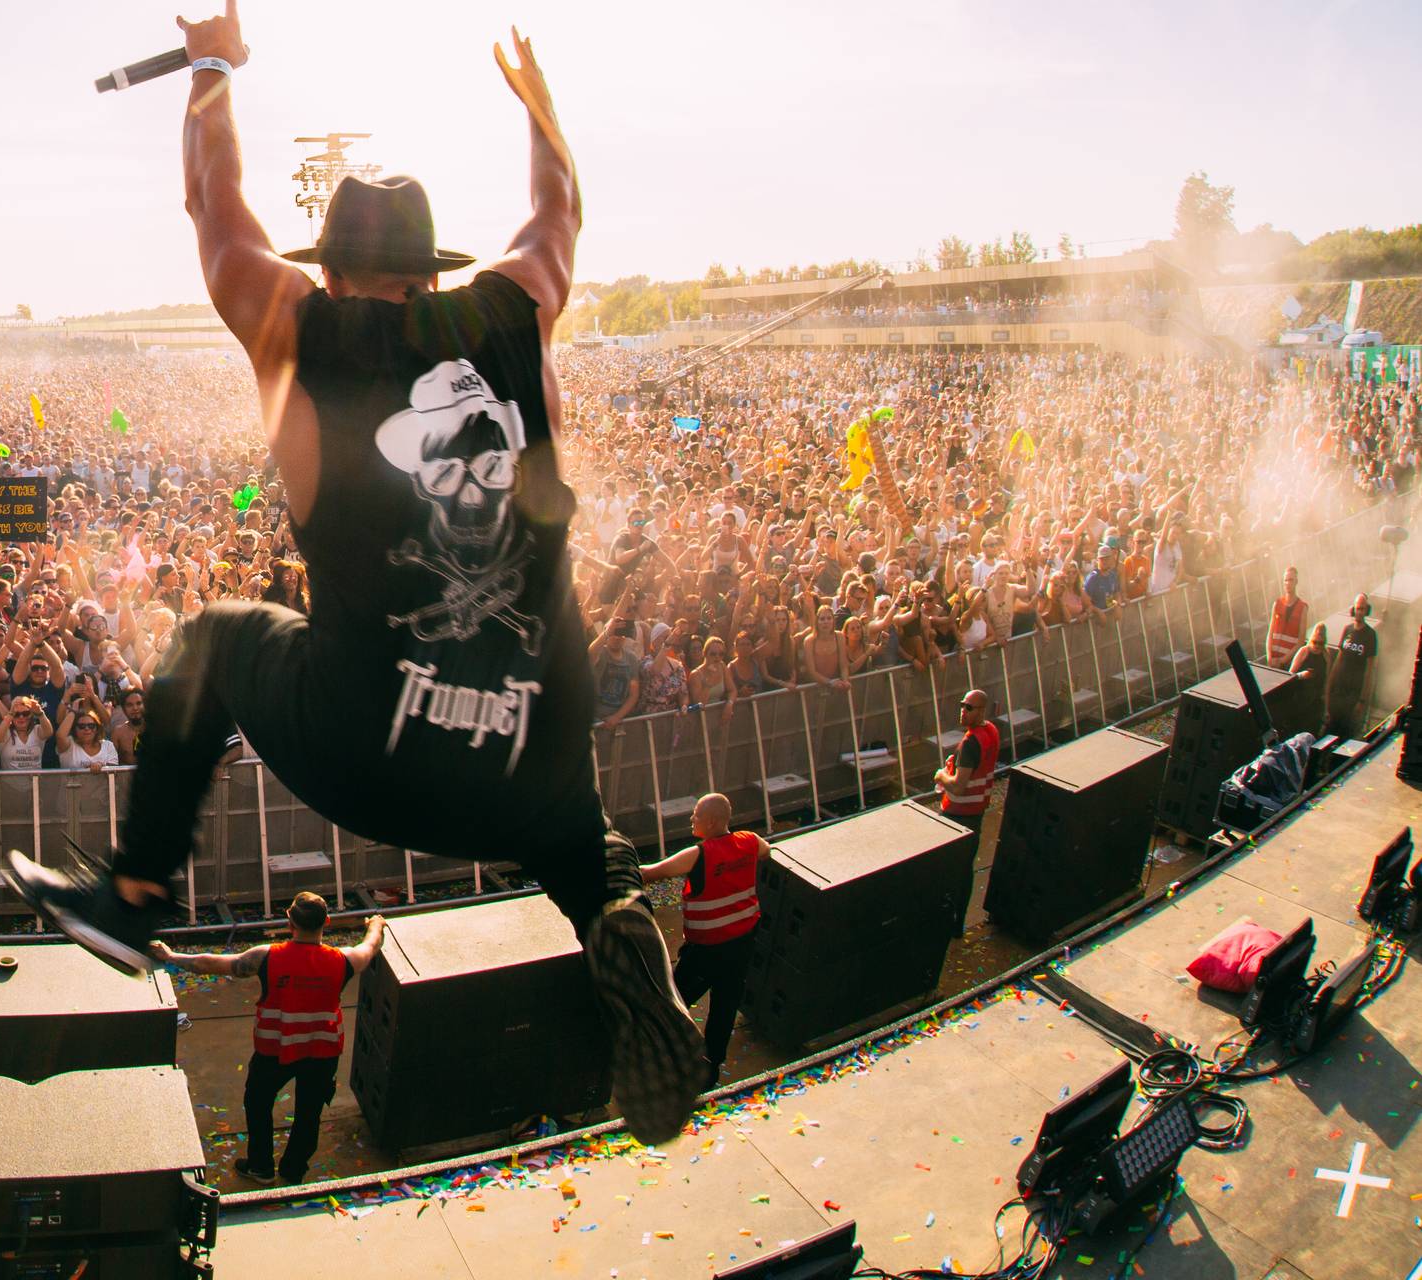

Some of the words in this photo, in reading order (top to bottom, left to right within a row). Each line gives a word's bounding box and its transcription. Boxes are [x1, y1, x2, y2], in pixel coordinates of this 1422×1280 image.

[9, 485, 37, 496] THE
[14, 504, 34, 515] BE
[15, 522, 47, 534] YOU
